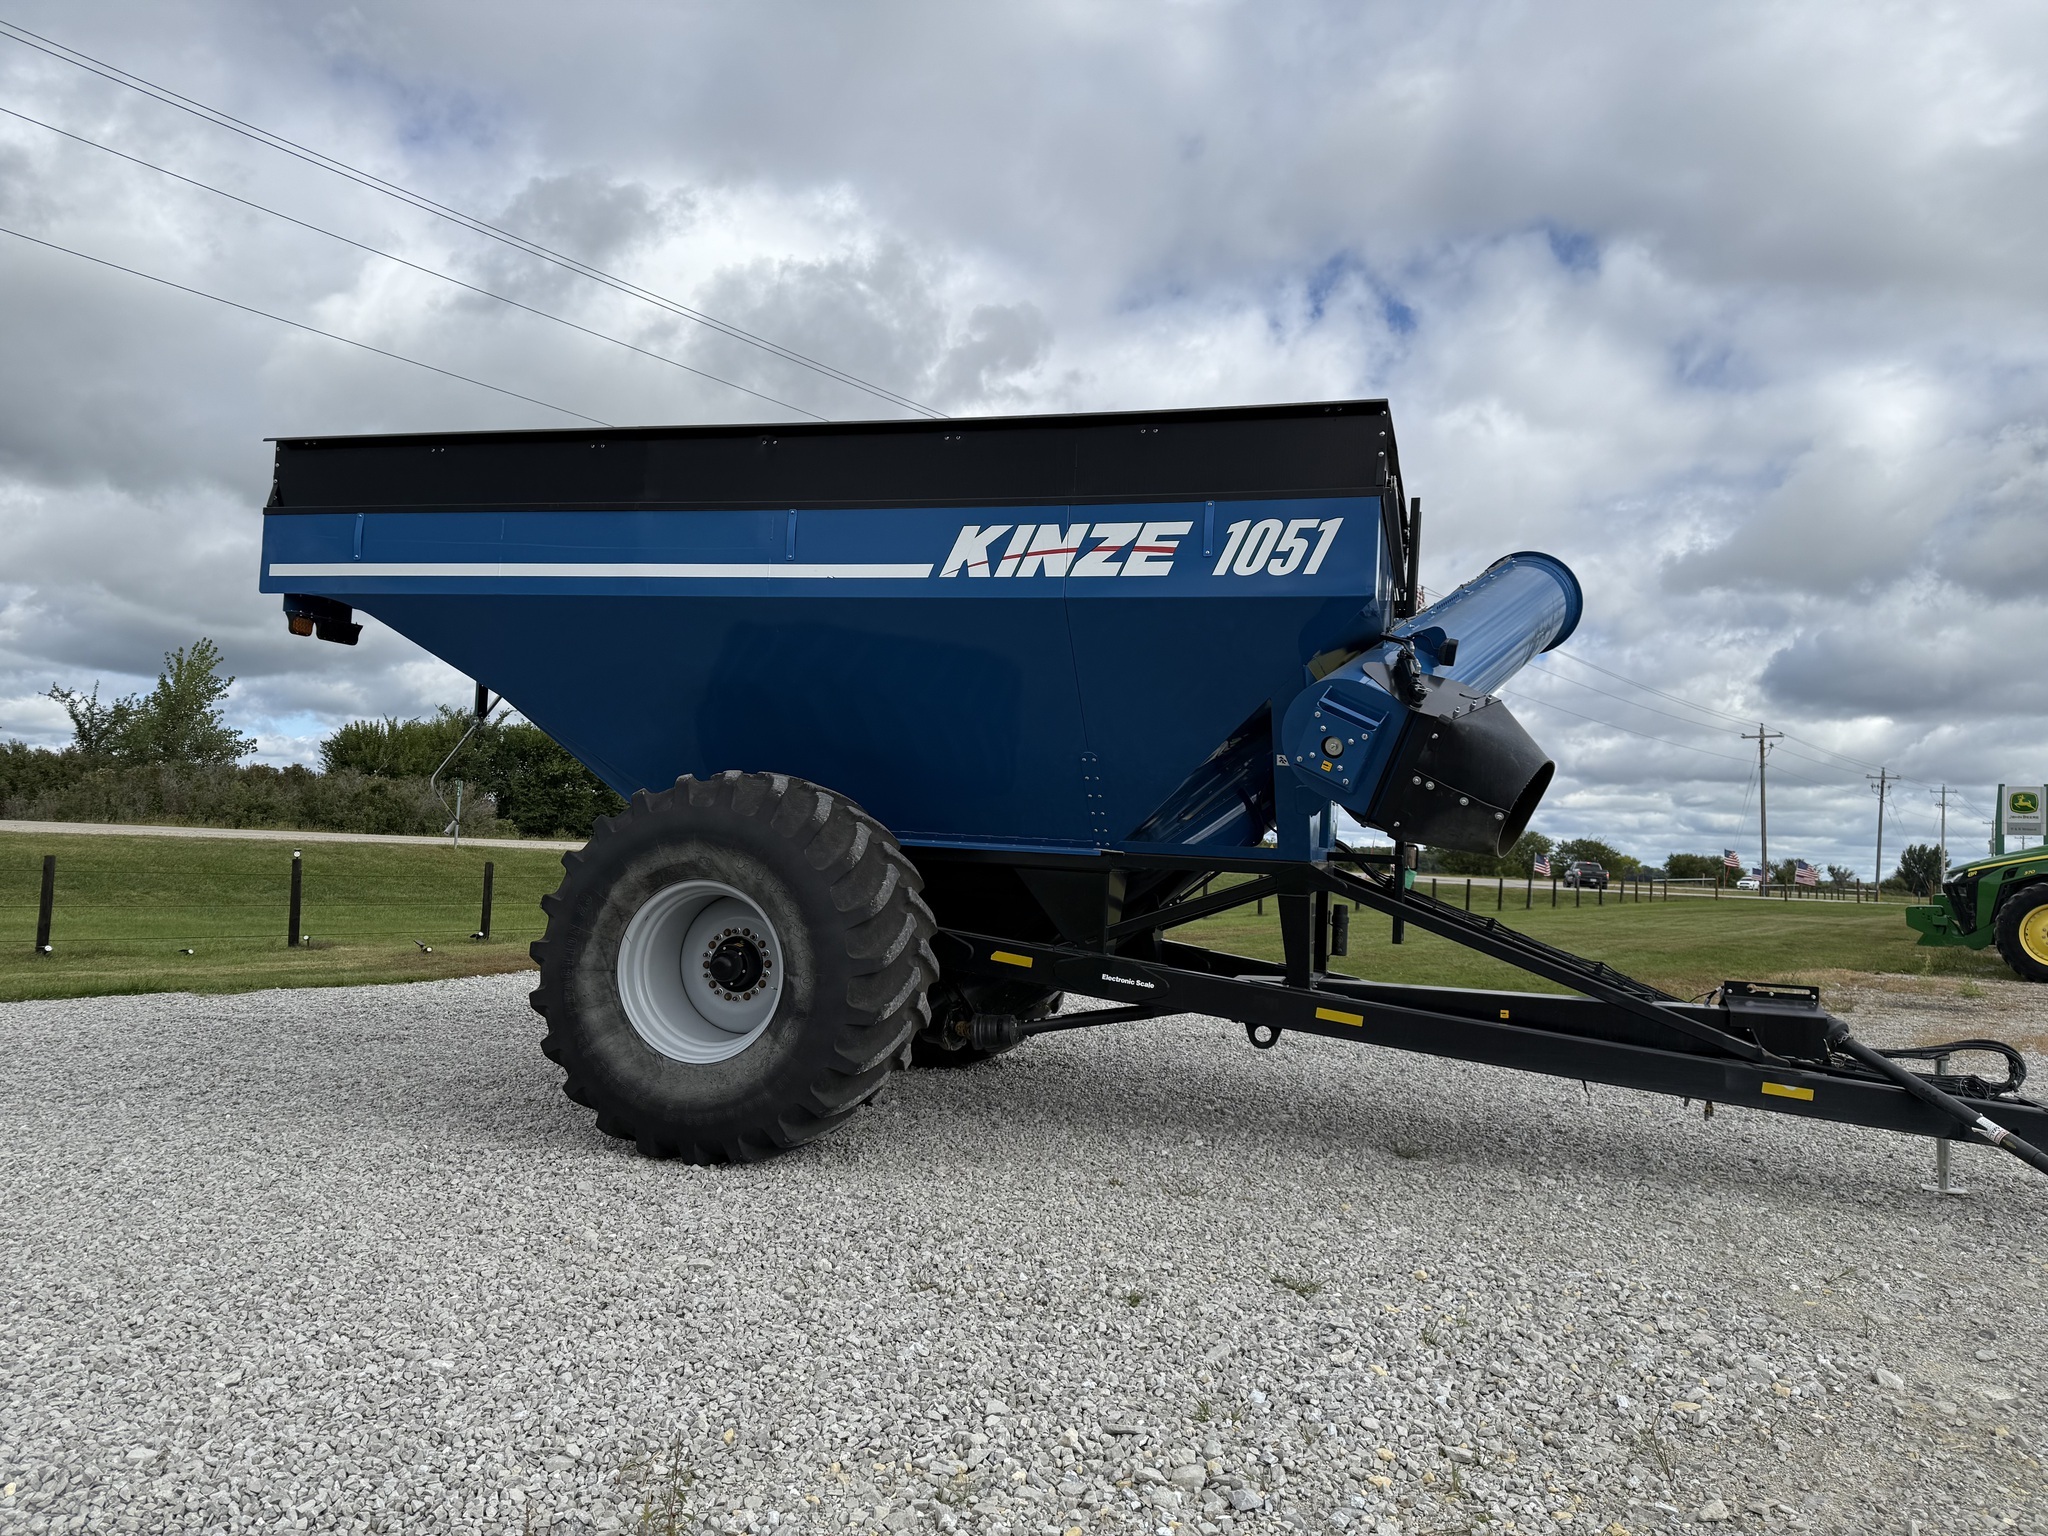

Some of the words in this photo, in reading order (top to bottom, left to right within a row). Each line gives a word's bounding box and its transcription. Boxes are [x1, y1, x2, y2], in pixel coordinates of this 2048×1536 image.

[938, 521, 1194, 578] KINZE
[1211, 517, 1344, 576] 1051
[1101, 973, 1135, 985] Electronic
[1135, 980, 1155, 989] Scale
